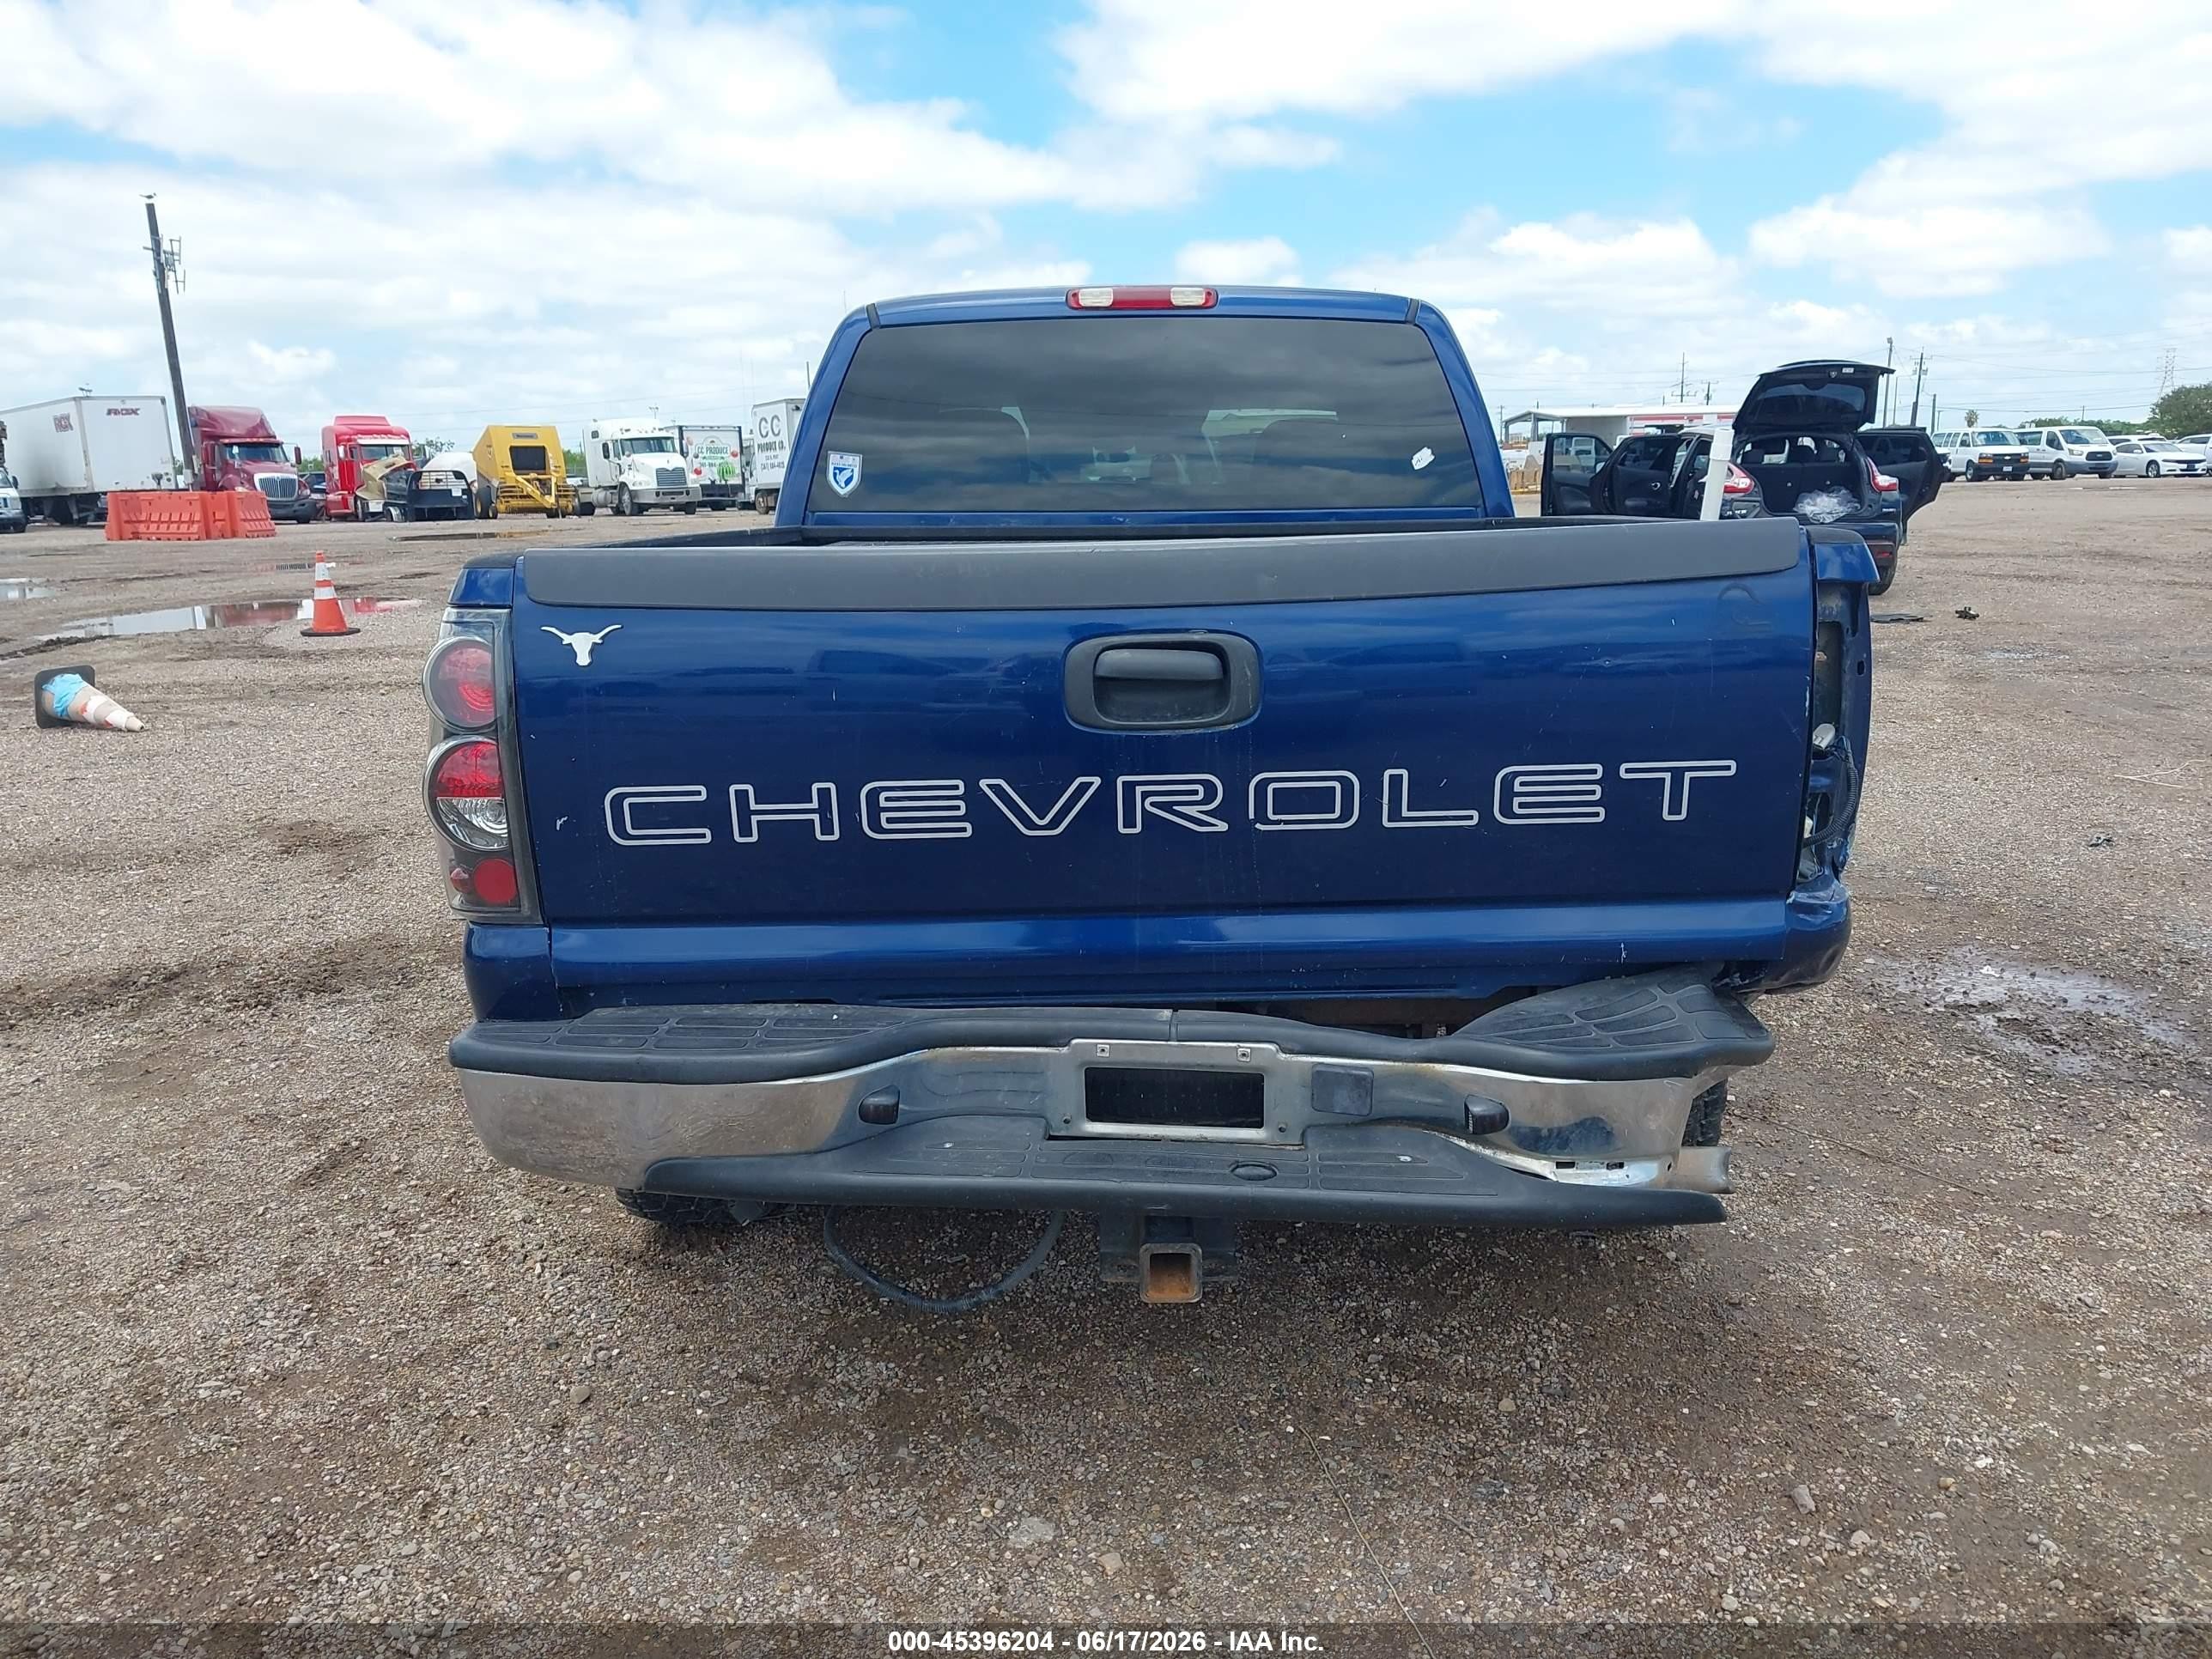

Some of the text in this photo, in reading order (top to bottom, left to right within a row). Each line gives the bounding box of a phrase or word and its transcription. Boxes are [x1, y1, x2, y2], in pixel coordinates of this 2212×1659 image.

[758, 415, 781, 438] CC
[706, 446, 728, 455] PRODUCE
[604, 759, 1737, 846] CHEVROLET
